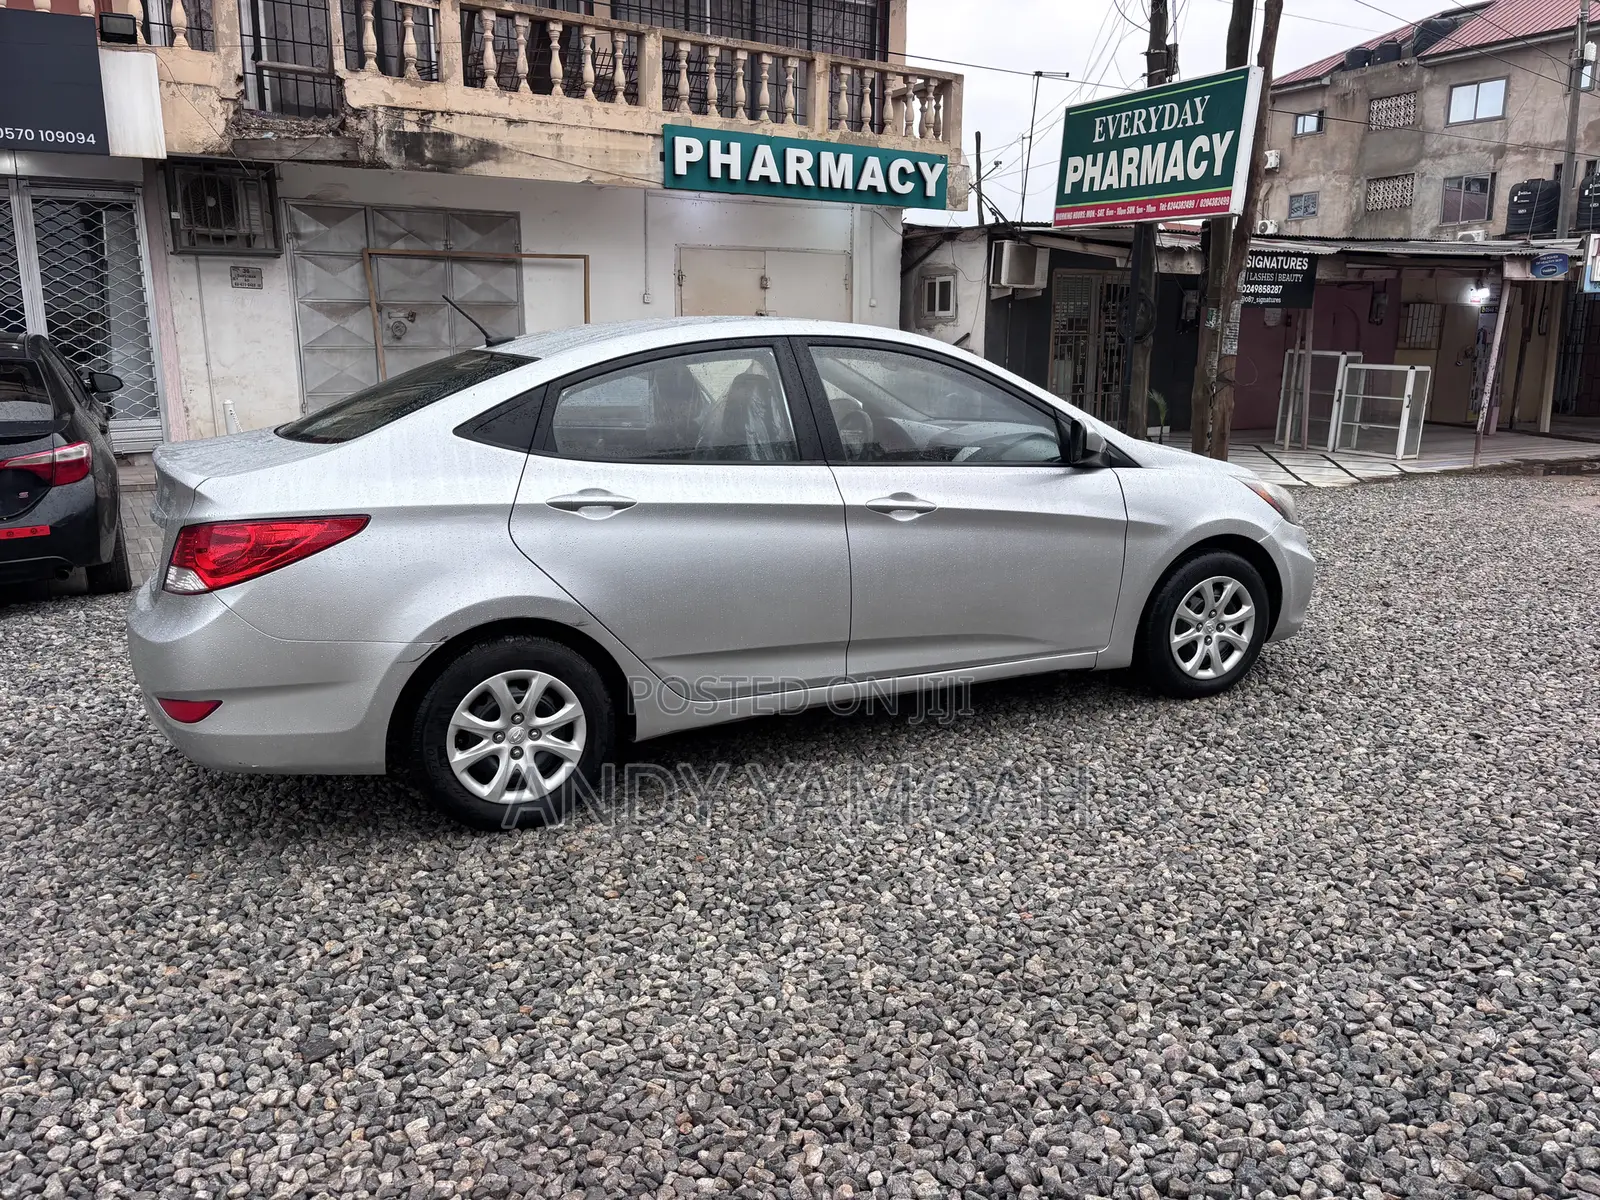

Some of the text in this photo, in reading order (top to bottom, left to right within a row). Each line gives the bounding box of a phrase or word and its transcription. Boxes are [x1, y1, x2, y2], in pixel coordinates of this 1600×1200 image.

[1092, 95, 1210, 143] EVERYDAY
[38, 129, 96, 145] 109094
[673, 136, 946, 197] PHARMACY
[1064, 130, 1235, 194] PHARMACY
[1246, 255, 1309, 270] SIGNATURES
[1249, 272, 1275, 282] LASHES
[1278, 273, 1304, 282] BEAUTY
[1241, 284, 1283, 294] 0249858287
[18, 491, 29, 499] S
